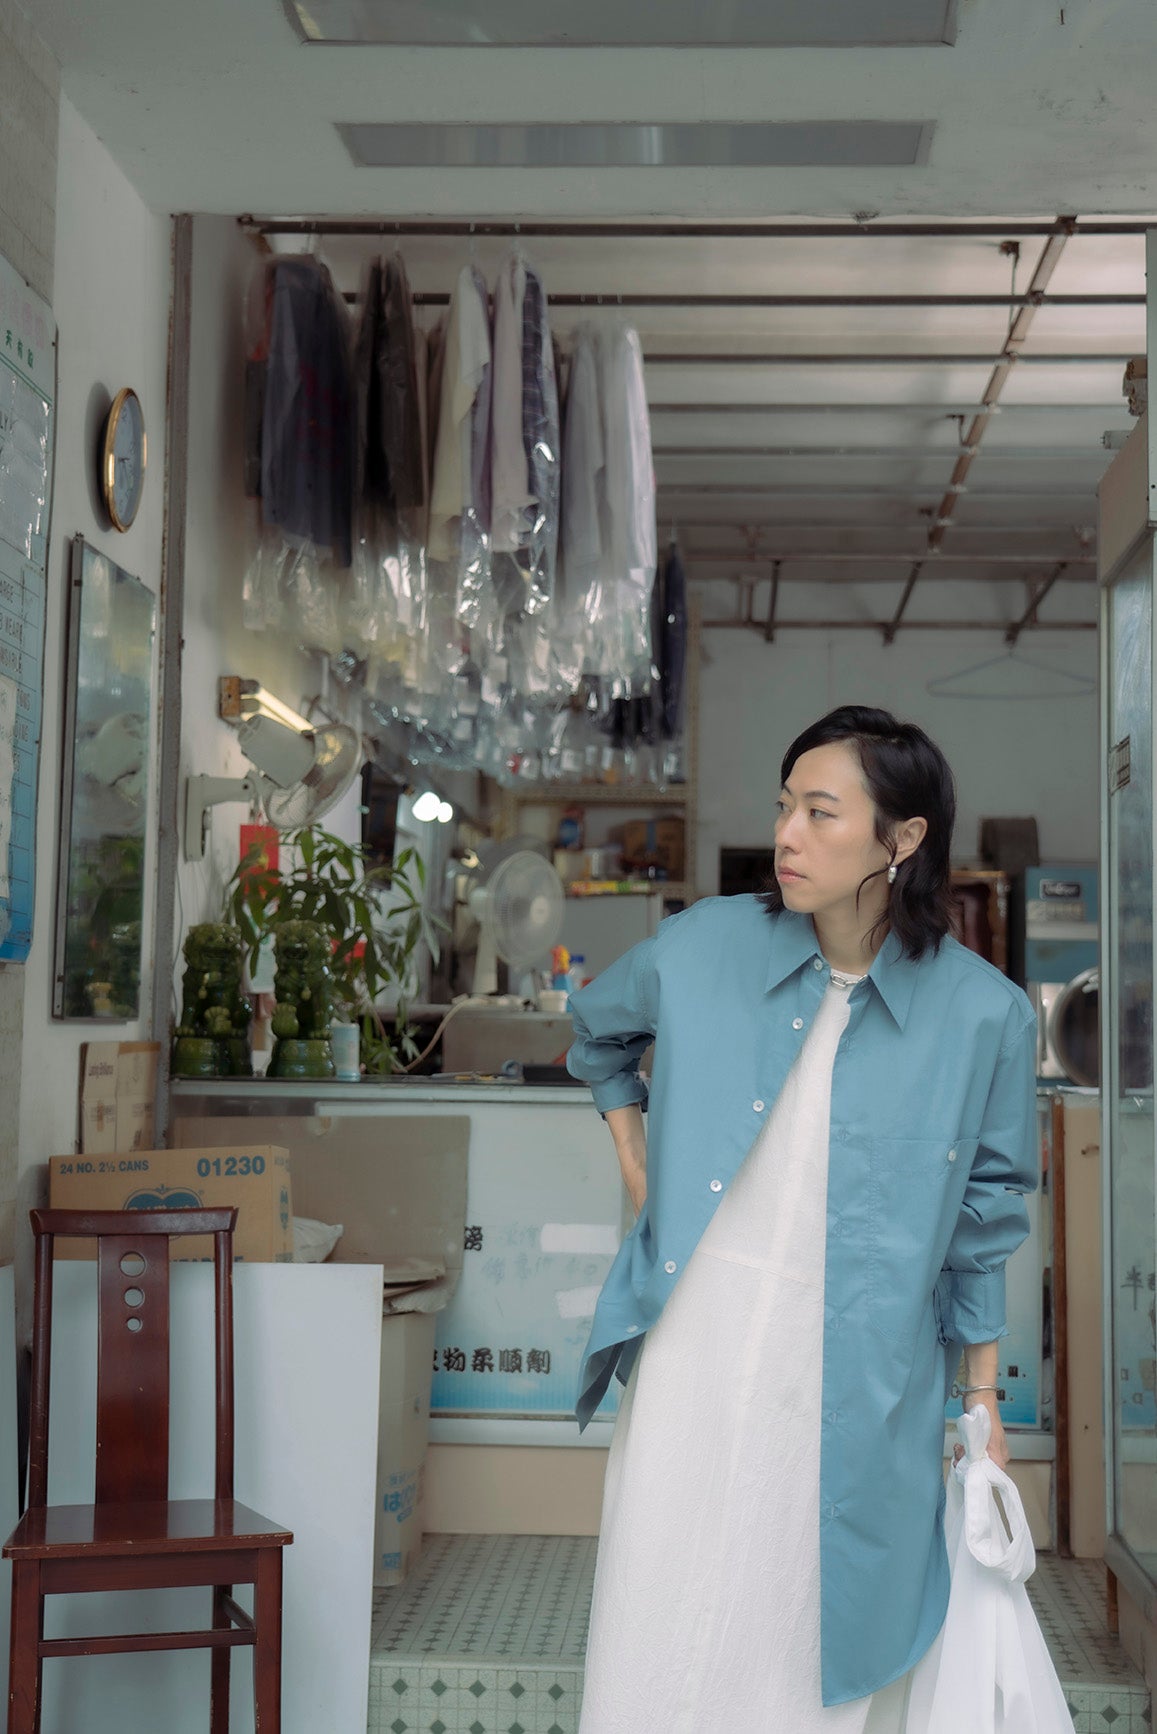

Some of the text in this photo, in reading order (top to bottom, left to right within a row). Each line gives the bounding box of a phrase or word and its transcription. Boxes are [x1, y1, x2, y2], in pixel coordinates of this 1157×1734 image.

[60, 1163, 73, 1175] 24
[76, 1162, 96, 1174] NO.
[118, 1160, 149, 1172] CANS
[197, 1155, 265, 1178] 01230
